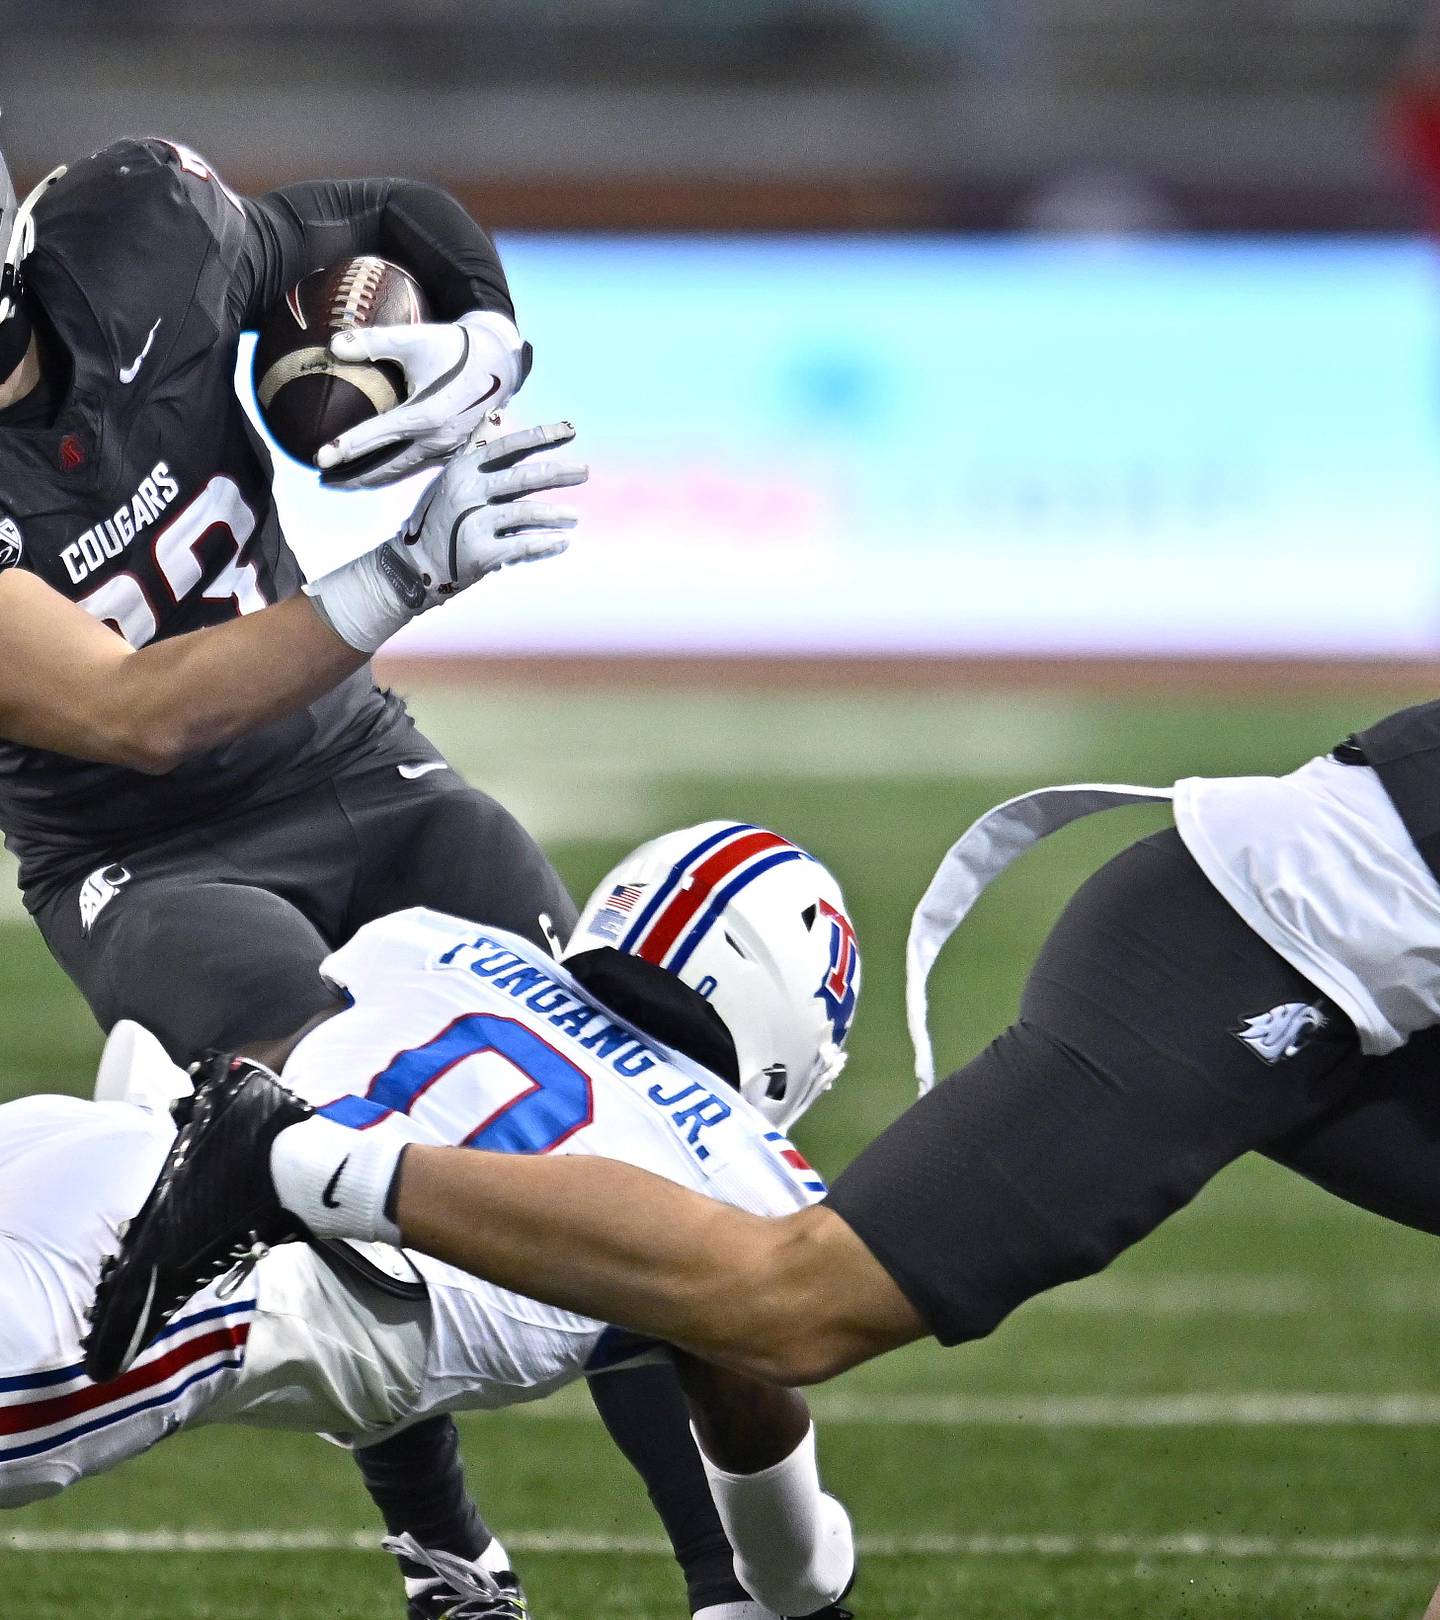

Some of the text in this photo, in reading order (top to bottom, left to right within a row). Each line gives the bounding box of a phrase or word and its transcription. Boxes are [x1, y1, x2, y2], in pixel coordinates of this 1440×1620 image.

[59, 461, 180, 585] COUGARS
[439, 936, 731, 1161] FONGANG JR.
